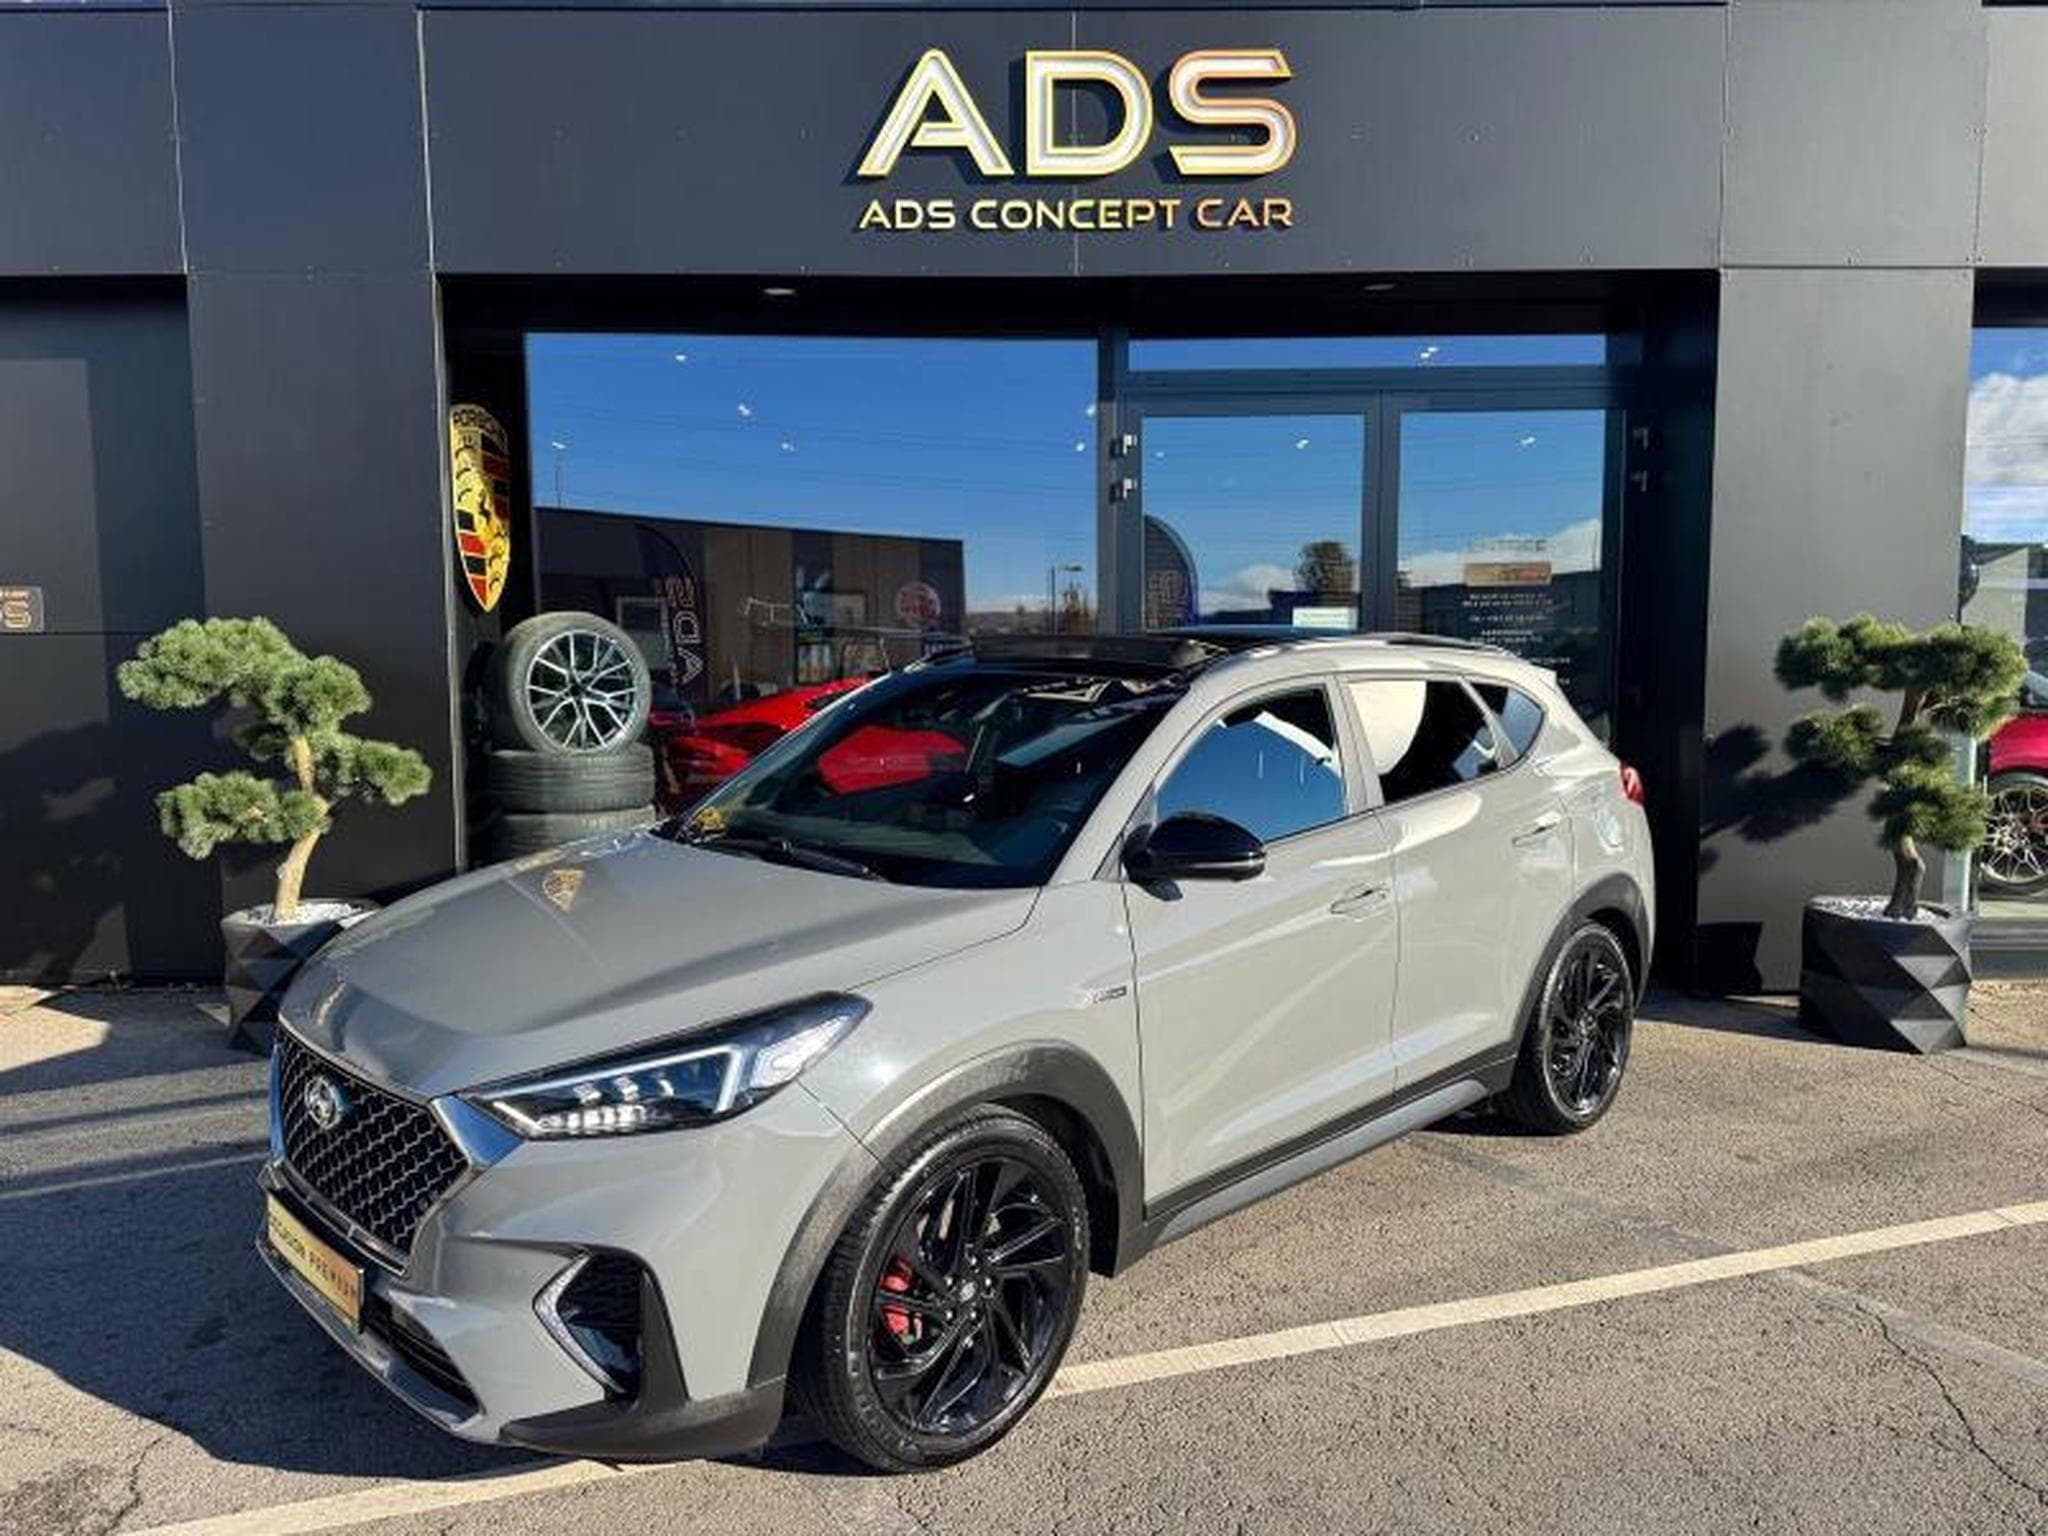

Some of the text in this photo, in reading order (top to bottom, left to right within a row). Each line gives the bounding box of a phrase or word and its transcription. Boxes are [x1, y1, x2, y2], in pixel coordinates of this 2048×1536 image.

[857, 48, 1297, 176] ADS
[858, 197, 1293, 230] ADS CONCEPT CAR
